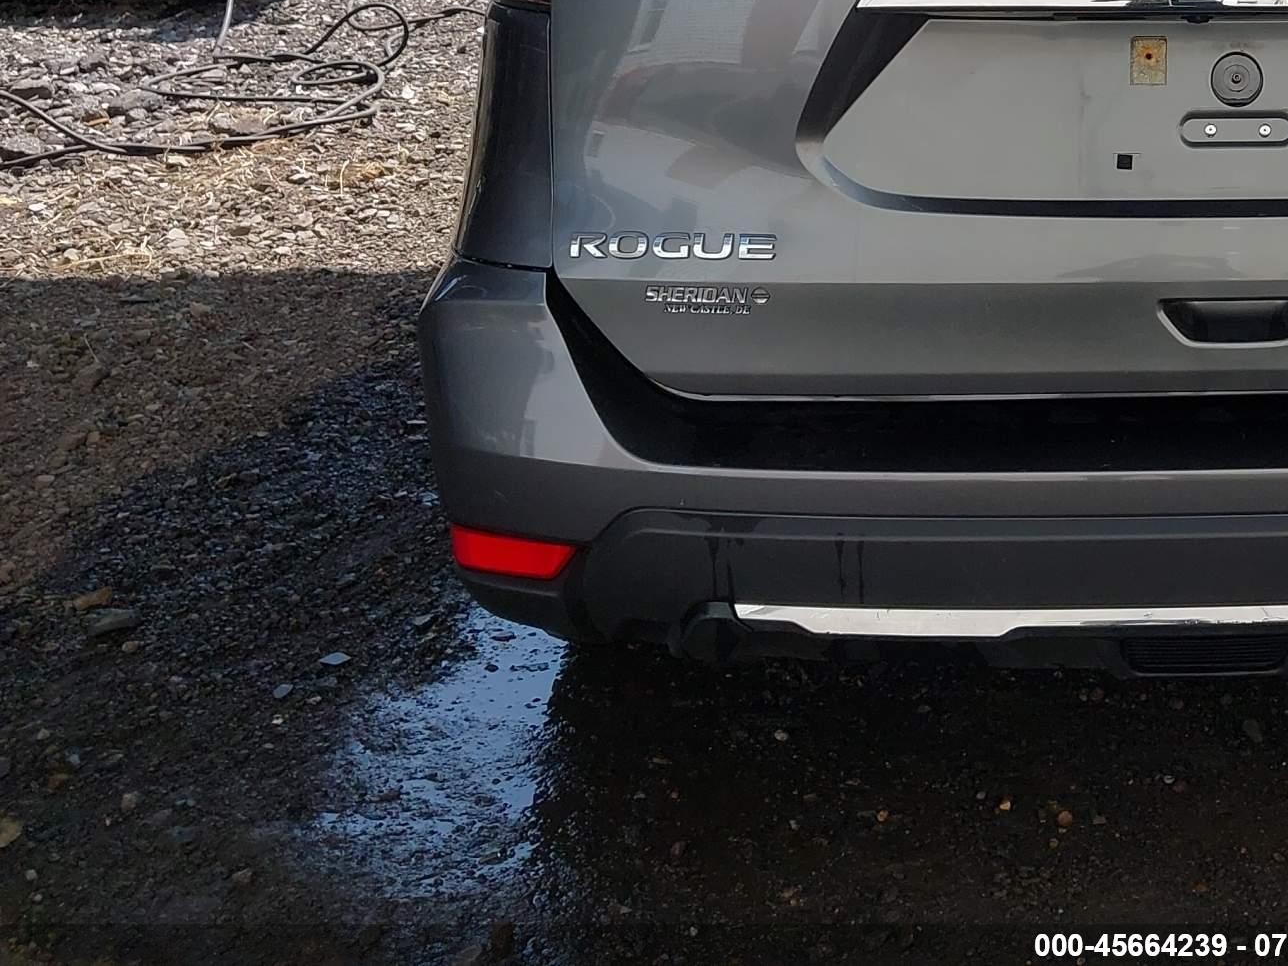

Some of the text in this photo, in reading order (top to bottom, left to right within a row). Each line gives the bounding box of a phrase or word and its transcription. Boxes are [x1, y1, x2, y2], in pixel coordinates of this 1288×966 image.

[568, 231, 778, 260] ROGUE
[645, 285, 749, 304] SHERIDAN
[664, 304, 687, 313] NEW
[736, 305, 752, 315] DE
